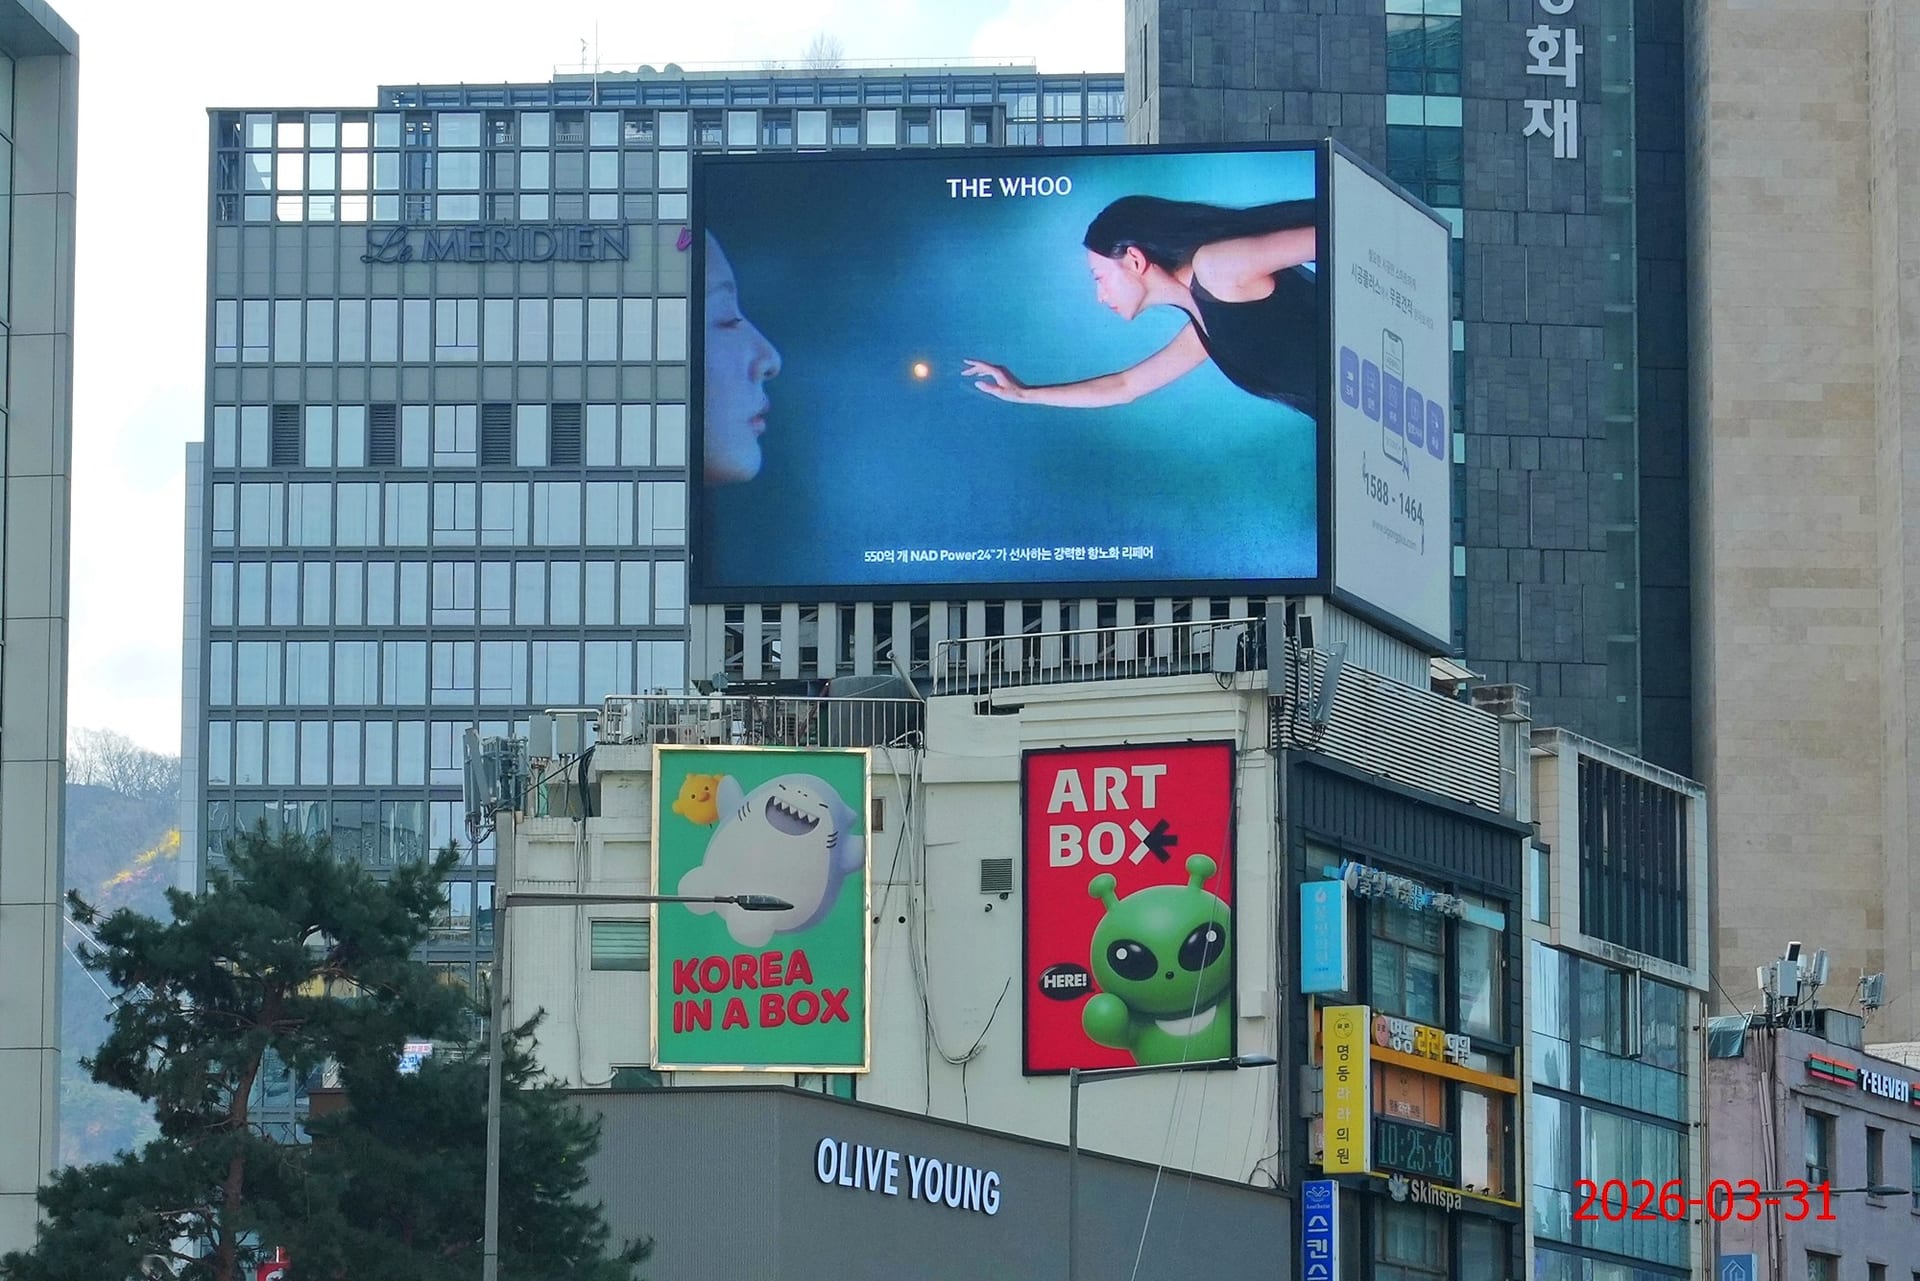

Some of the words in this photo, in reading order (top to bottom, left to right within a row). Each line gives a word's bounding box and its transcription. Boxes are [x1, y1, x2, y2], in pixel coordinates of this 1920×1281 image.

[946, 178, 993, 198] THE
[998, 176, 1072, 196] WHOO
[421, 226, 630, 264] MERIDIEN
[864, 549, 895, 563] 550억
[897, 549, 909, 563] 개
[910, 550, 939, 561] NAD
[1009, 547, 1053, 561] 선사하는
[1054, 546, 1086, 561] 강력한
[1087, 546, 1120, 560] 항노화
[1121, 545, 1154, 560] 리페어
[1047, 763, 1168, 815] ART
[1049, 818, 1174, 868] BOX
[673, 949, 814, 995] KOREA
[1044, 973, 1088, 989] HERE!
[673, 999, 712, 1034] IN
[721, 997, 750, 1030] A
[759, 987, 850, 1029] BOX
[1378, 1123, 1453, 1178] 10:25:48
[816, 1137, 900, 1196] OLIVE
[907, 1155, 1000, 1215] YOUNG
[1411, 1180, 1462, 1213] Skinspa
